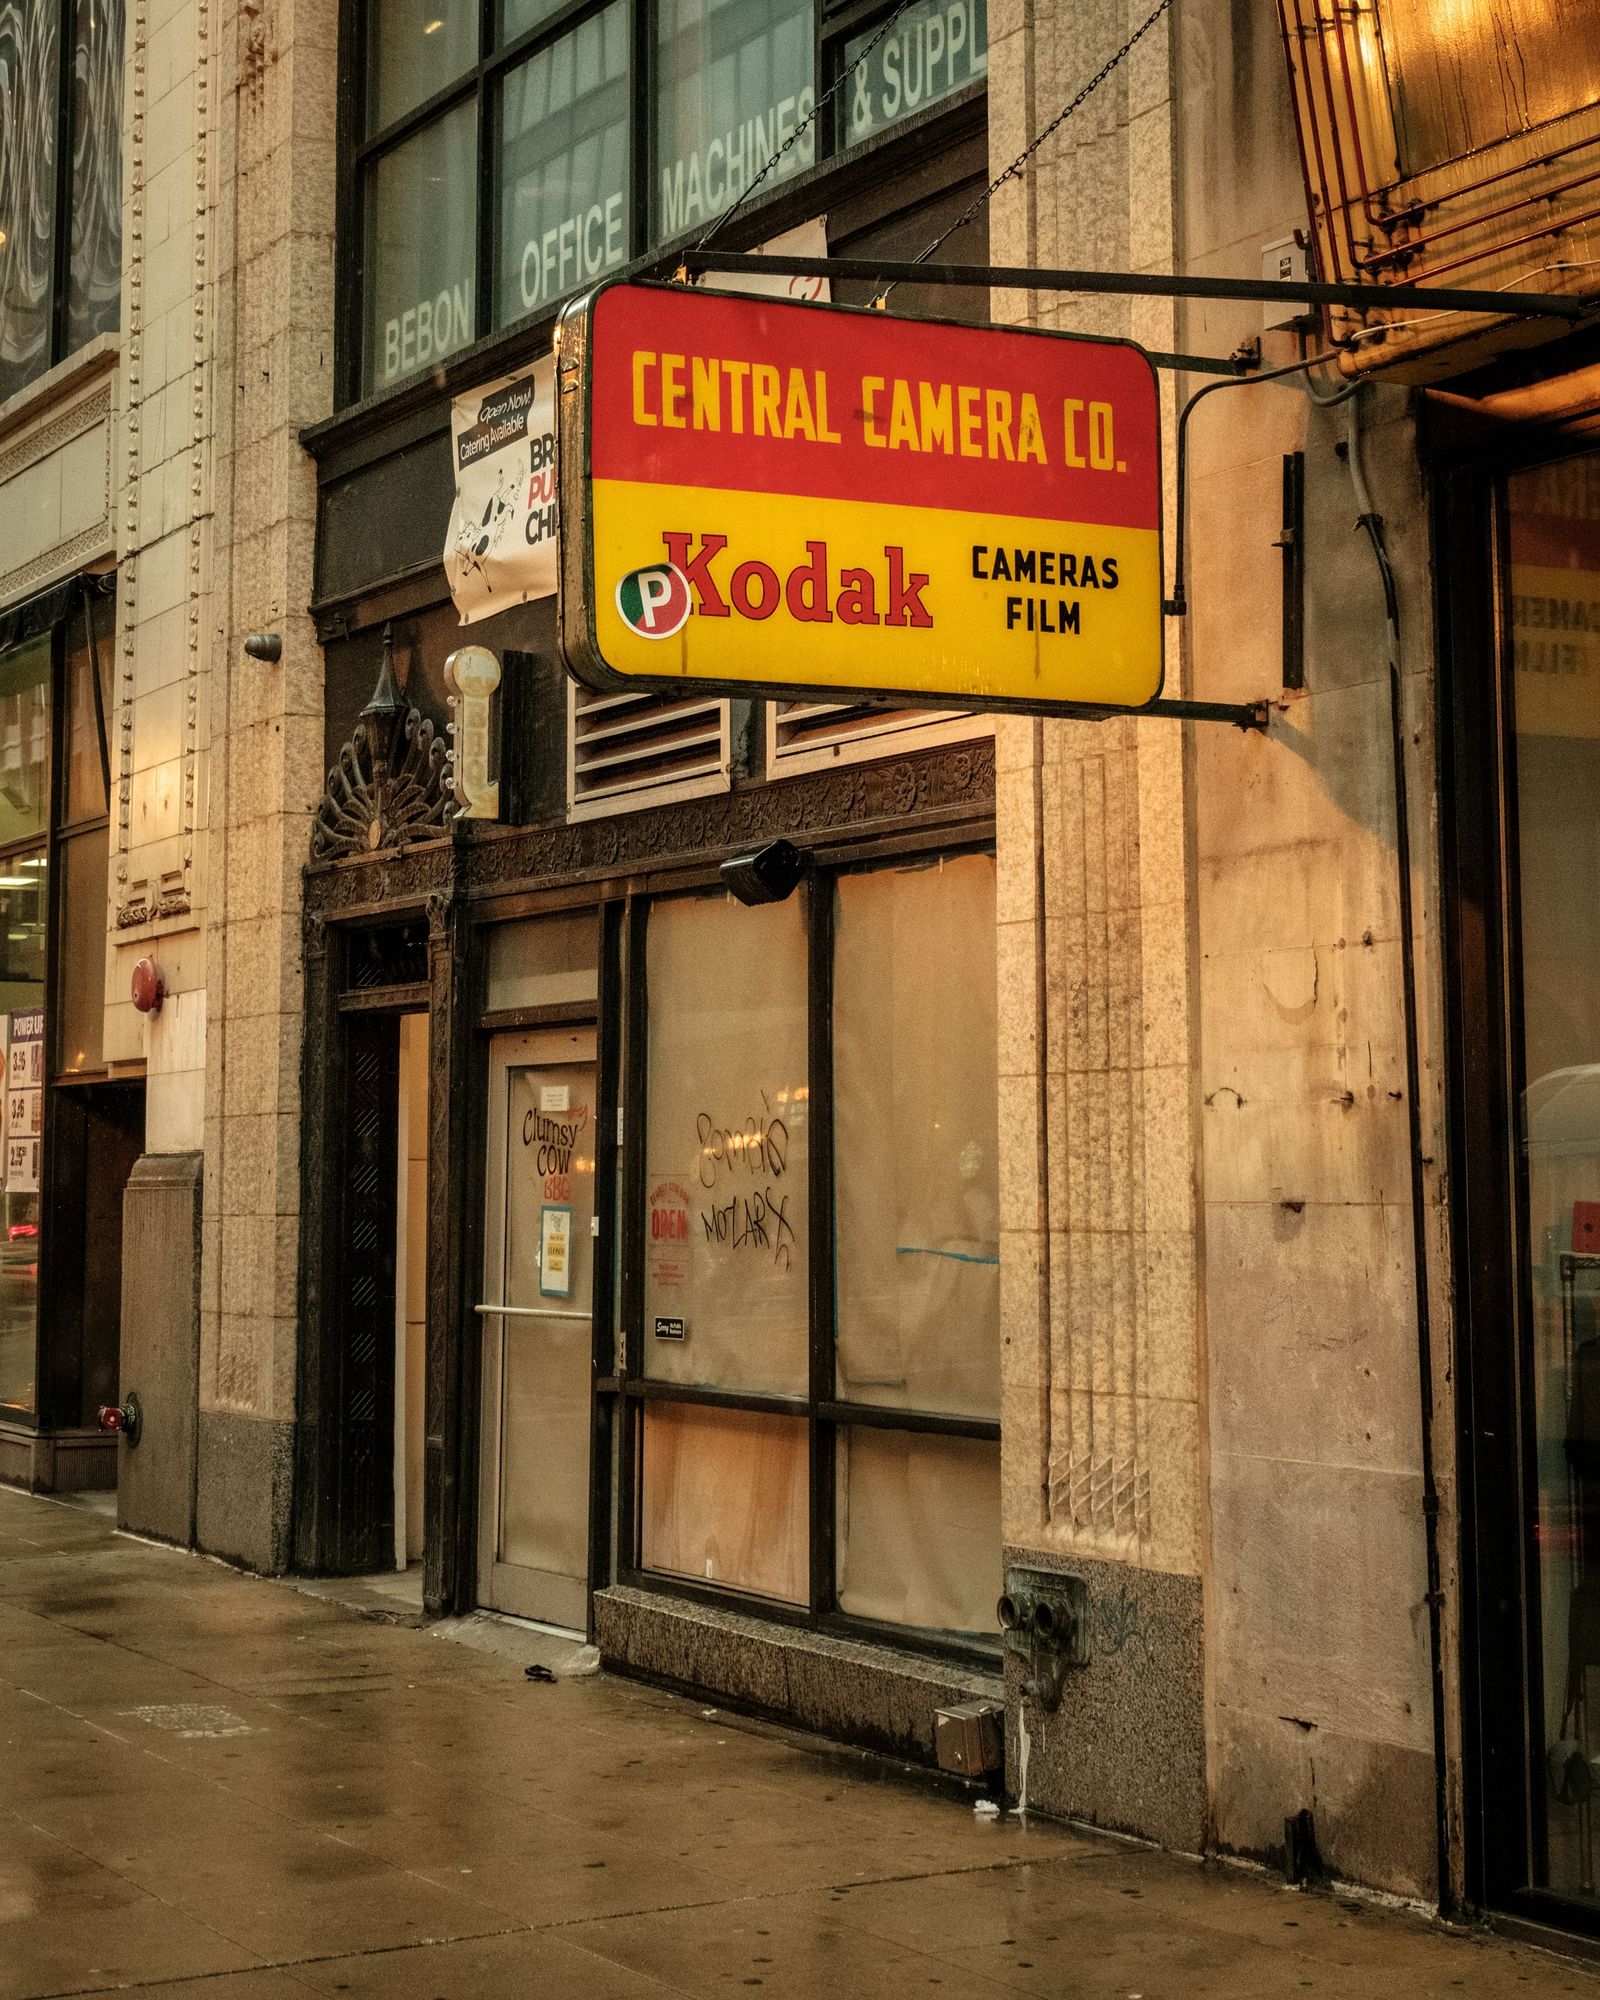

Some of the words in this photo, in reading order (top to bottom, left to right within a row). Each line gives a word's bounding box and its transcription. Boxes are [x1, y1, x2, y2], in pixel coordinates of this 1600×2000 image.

[384, 278, 470, 379] BEBON
[520, 191, 623, 309] OFFICE
[662, 86, 815, 237] MACHINES
[852, 57, 873, 134] &
[480, 402, 507, 424] Open
[506, 387, 532, 412] Now!
[632, 350, 842, 444] CENTRAL
[862, 375, 1048, 466] CAMERA
[1064, 398, 1127, 473] CO.
[460, 434, 491, 460] Catering
[490, 413, 524, 445] Available
[662, 531, 934, 628] Kodak
[971, 545, 1119, 590] CAMERAS
[637, 571, 672, 628] P
[1006, 597, 1081, 635] FILM
[523, 1107, 578, 1149] Clumsy
[652, 1209, 688, 1240] OPEN
[656, 1321, 669, 1335] Sorry
